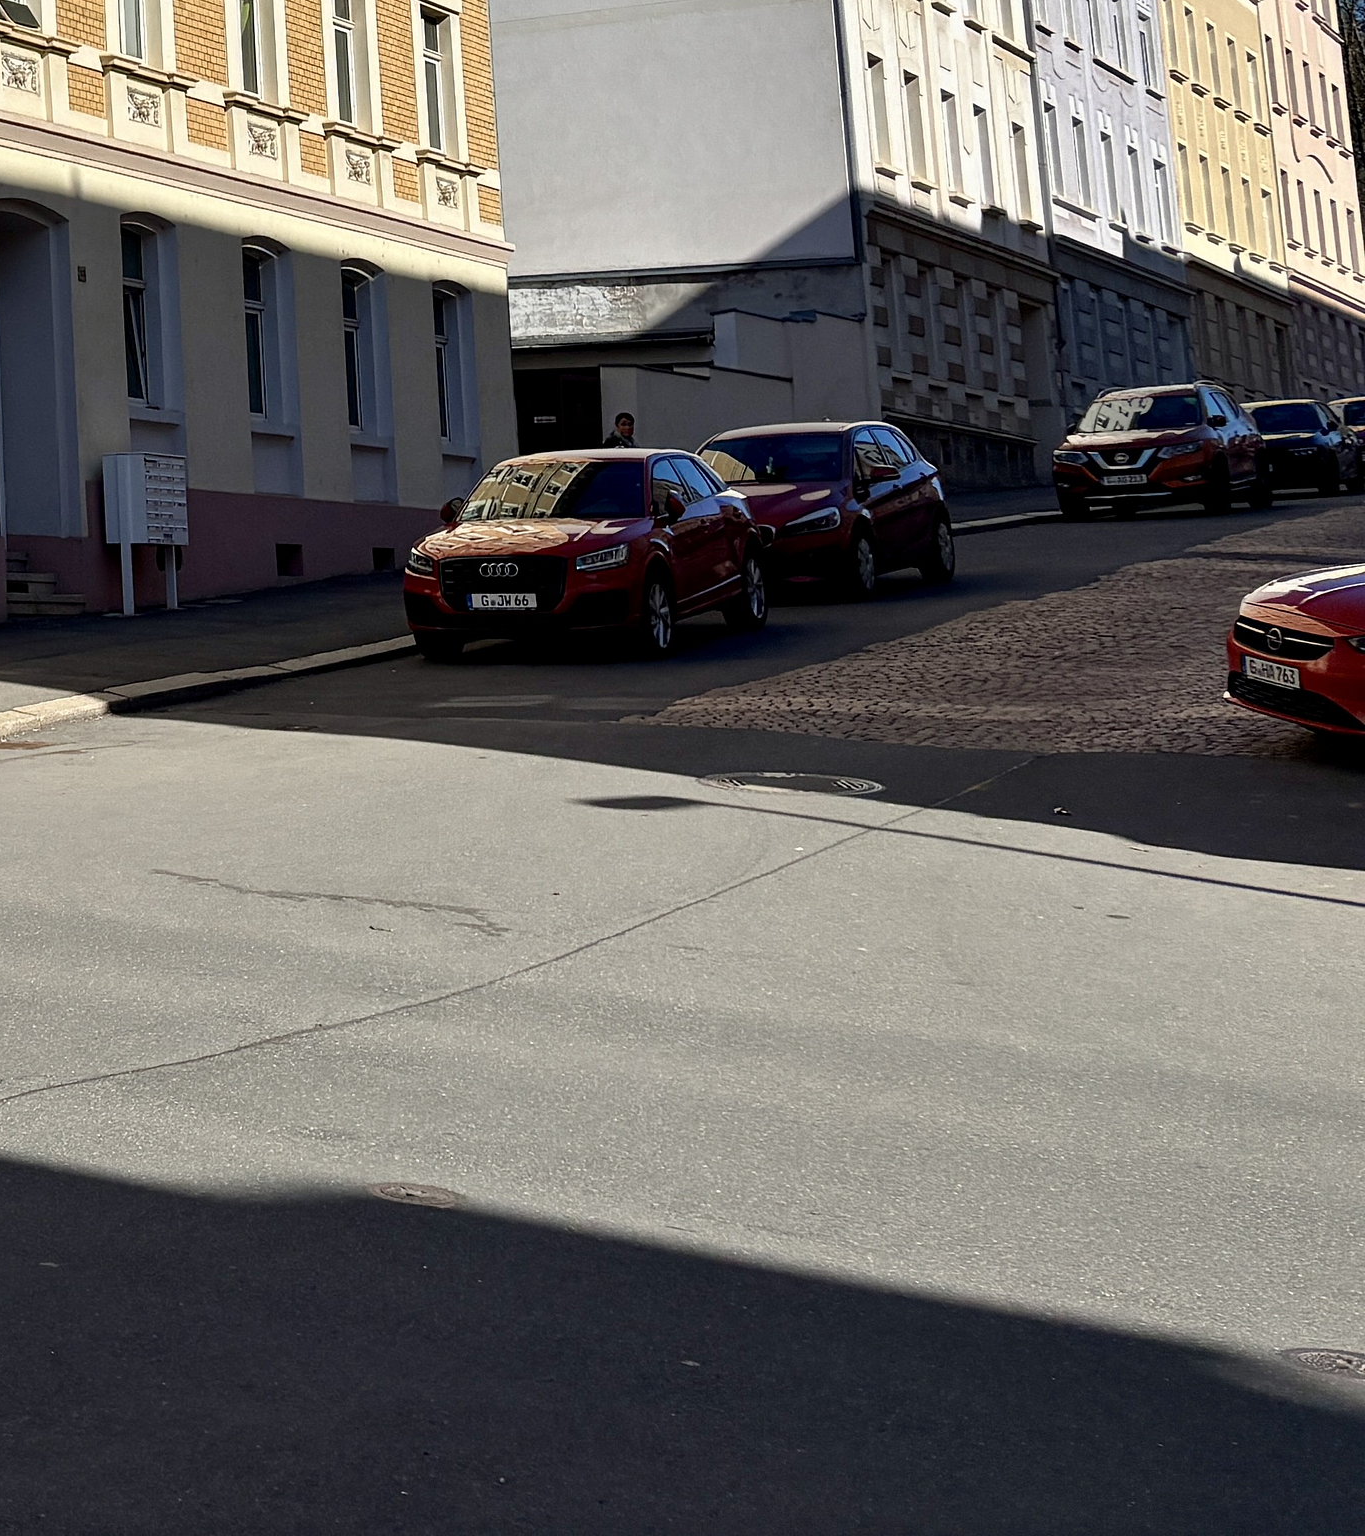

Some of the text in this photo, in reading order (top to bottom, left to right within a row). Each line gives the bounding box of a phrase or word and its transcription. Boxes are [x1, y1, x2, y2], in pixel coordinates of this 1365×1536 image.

[481, 594, 489, 607] G
[514, 594, 529, 607] 66
[1275, 665, 1295, 684] 763
